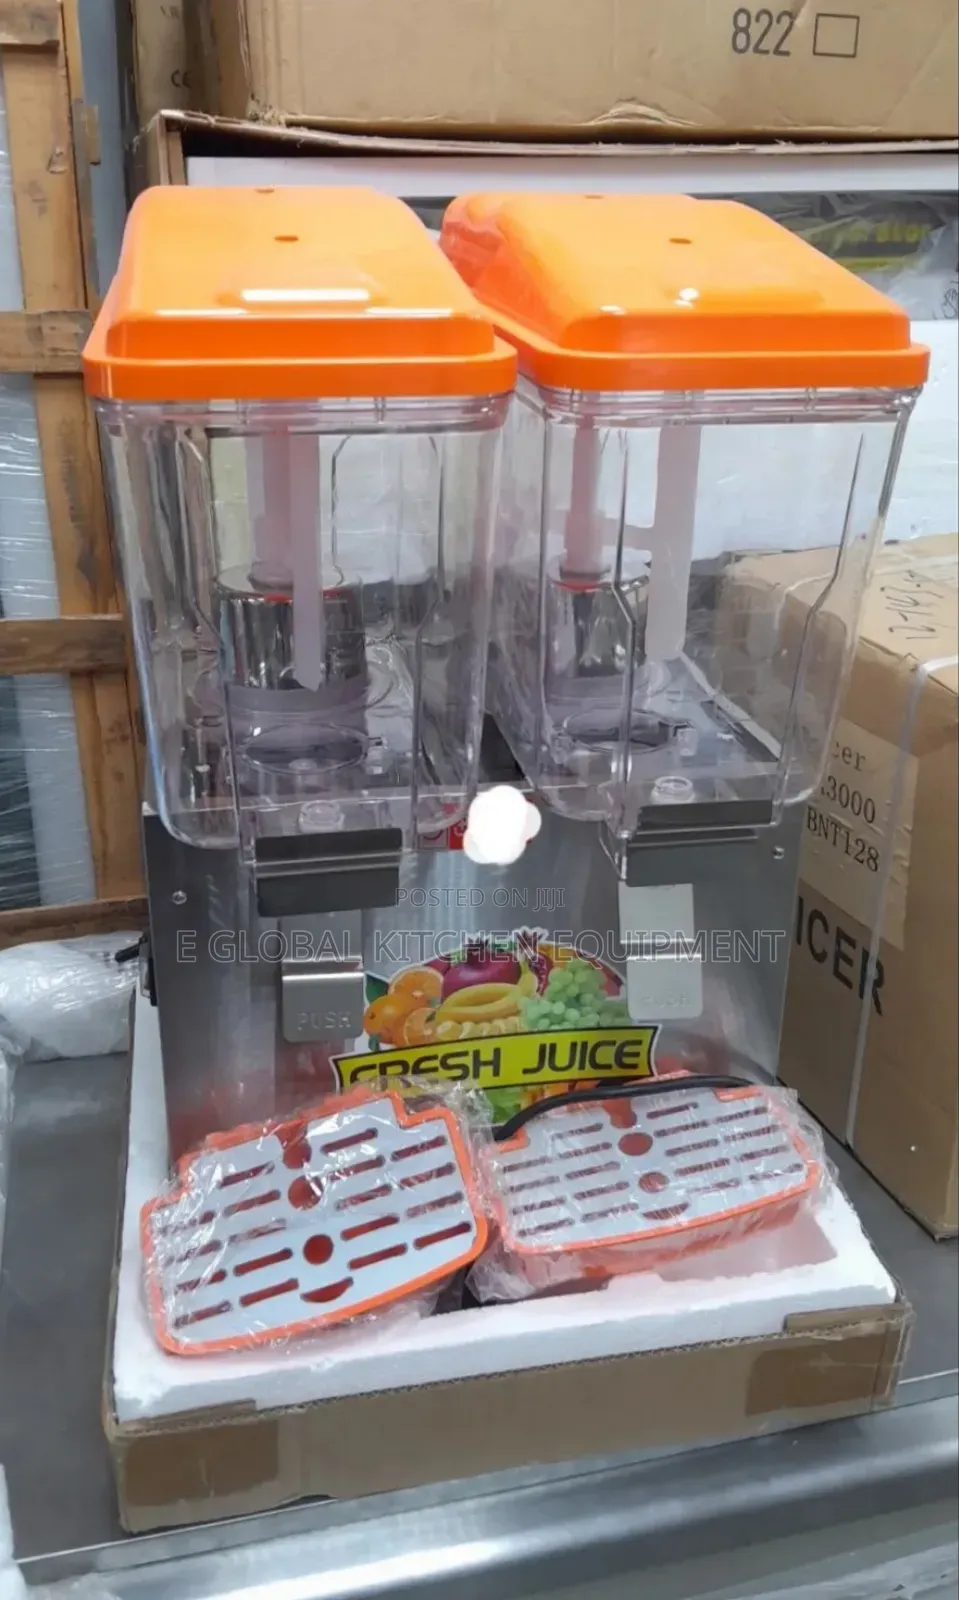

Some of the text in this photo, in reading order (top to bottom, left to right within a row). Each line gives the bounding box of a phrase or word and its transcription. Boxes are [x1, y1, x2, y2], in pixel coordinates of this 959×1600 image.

[731, 7, 796, 57] 822
[806, 805, 879, 872] BNT128
[296, 1011, 351, 1031] PUSH
[522, 1039, 643, 1075] JUICE
